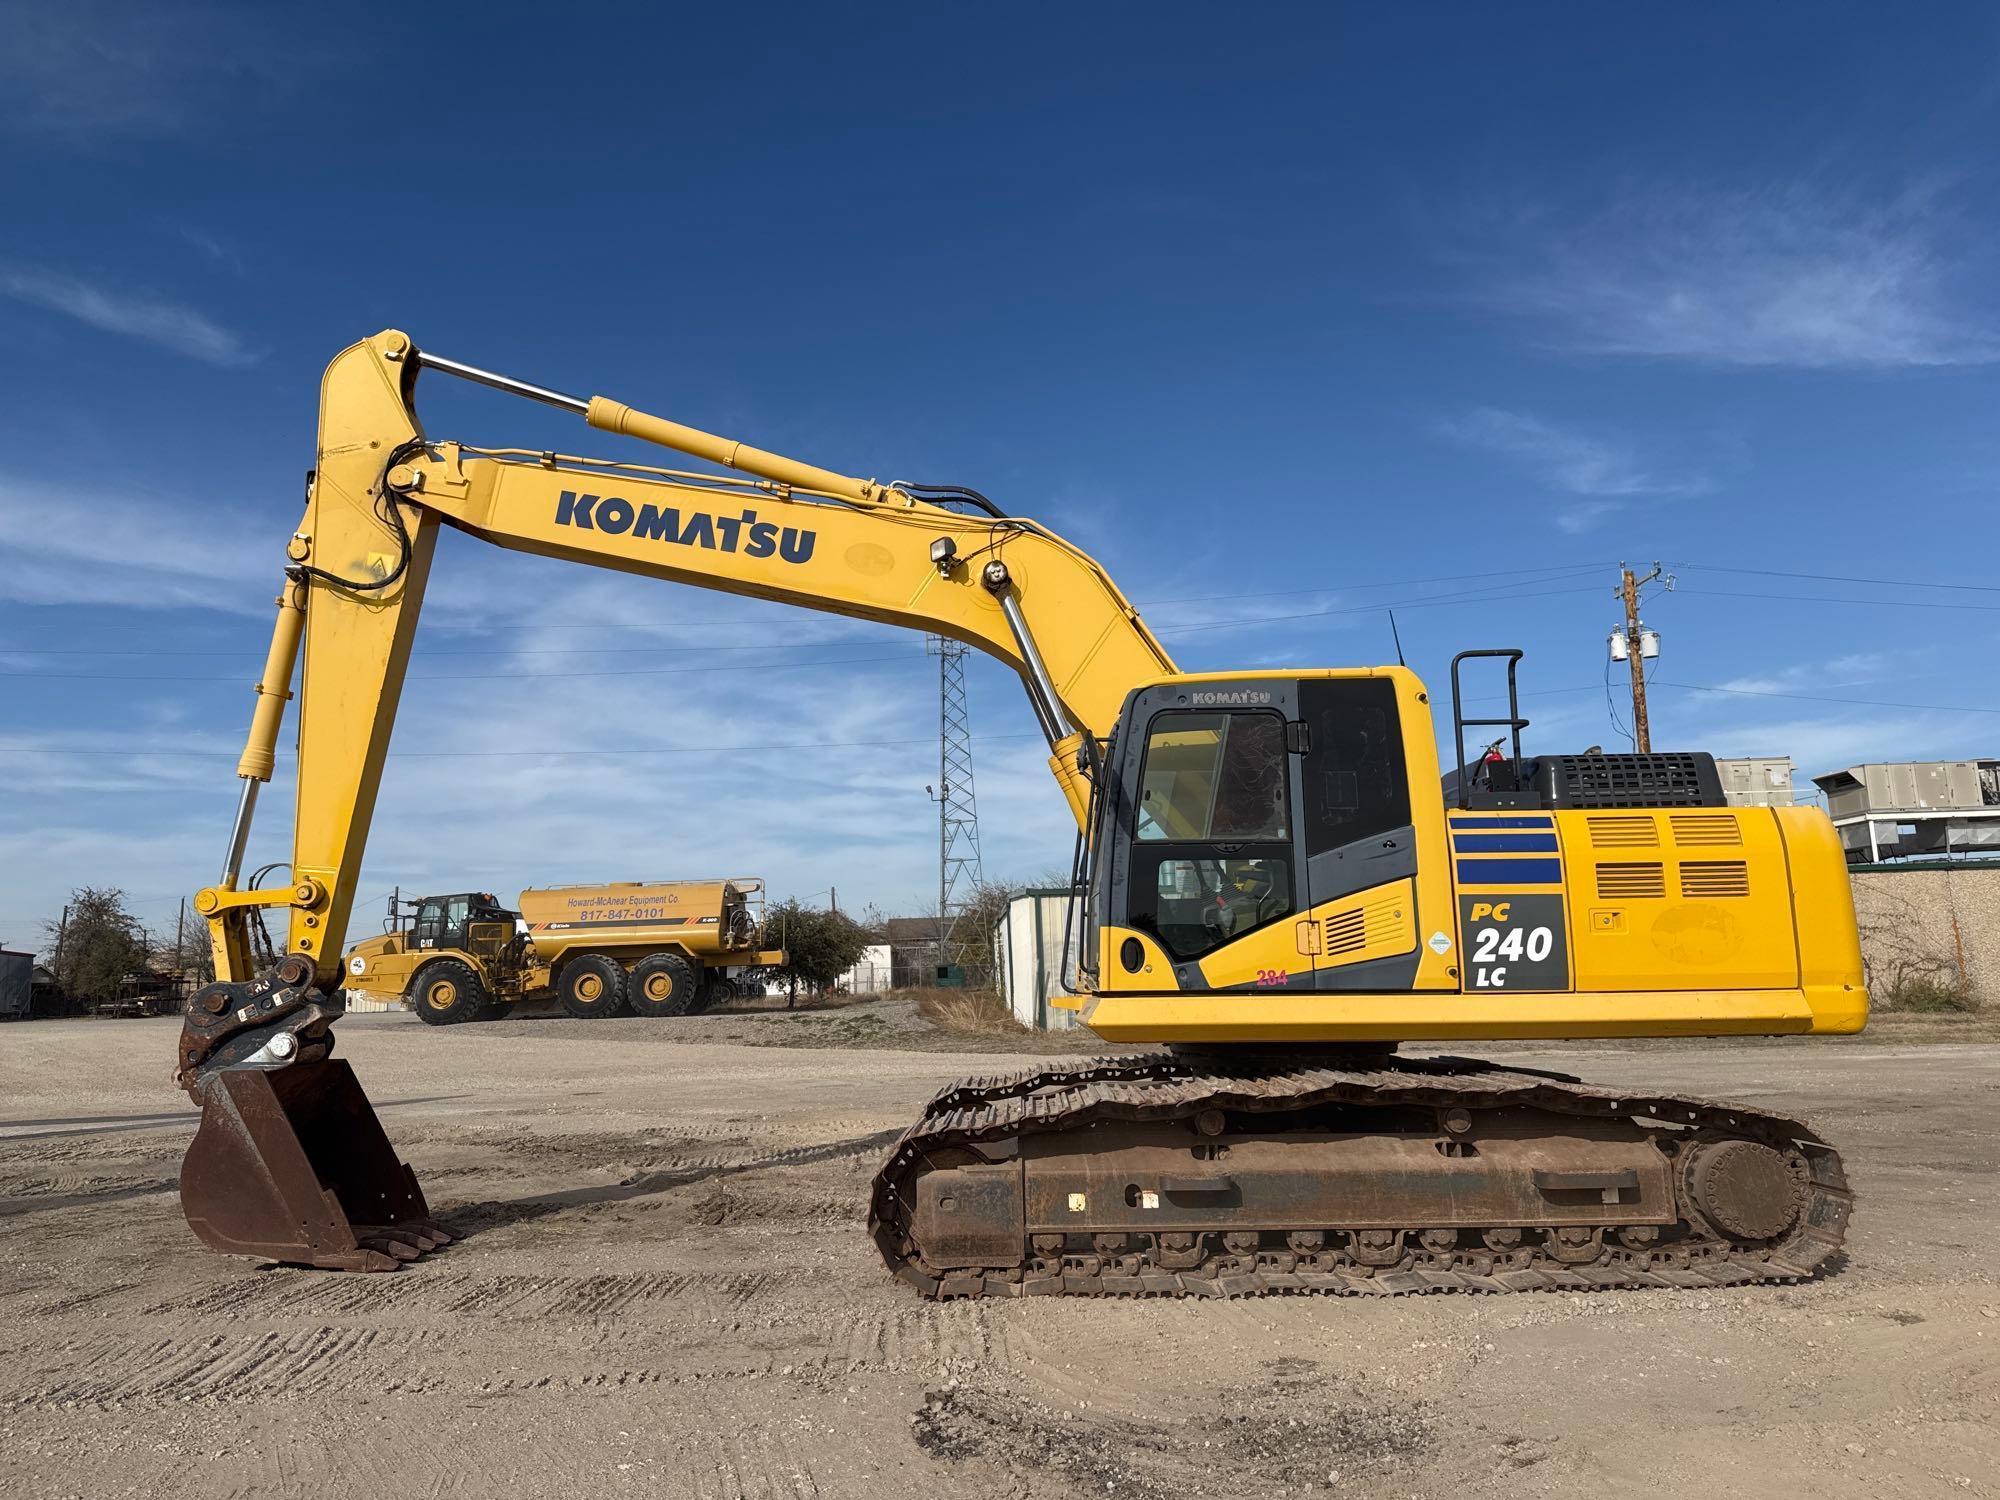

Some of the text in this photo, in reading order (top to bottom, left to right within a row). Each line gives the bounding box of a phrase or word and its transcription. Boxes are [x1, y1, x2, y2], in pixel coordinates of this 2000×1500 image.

[555, 490, 817, 564] KOMATSU
[1192, 690, 1271, 704] KOMATSU
[568, 894, 680, 907] Howard-McAnear Equipment Co.
[580, 908, 664, 920] 817-847-0101
[1470, 903, 1511, 922] PC
[420, 939, 434, 948] CAT
[1472, 926, 1553, 963] 240
[1256, 969, 1288, 986] 284
[1476, 967, 1507, 987] LC
